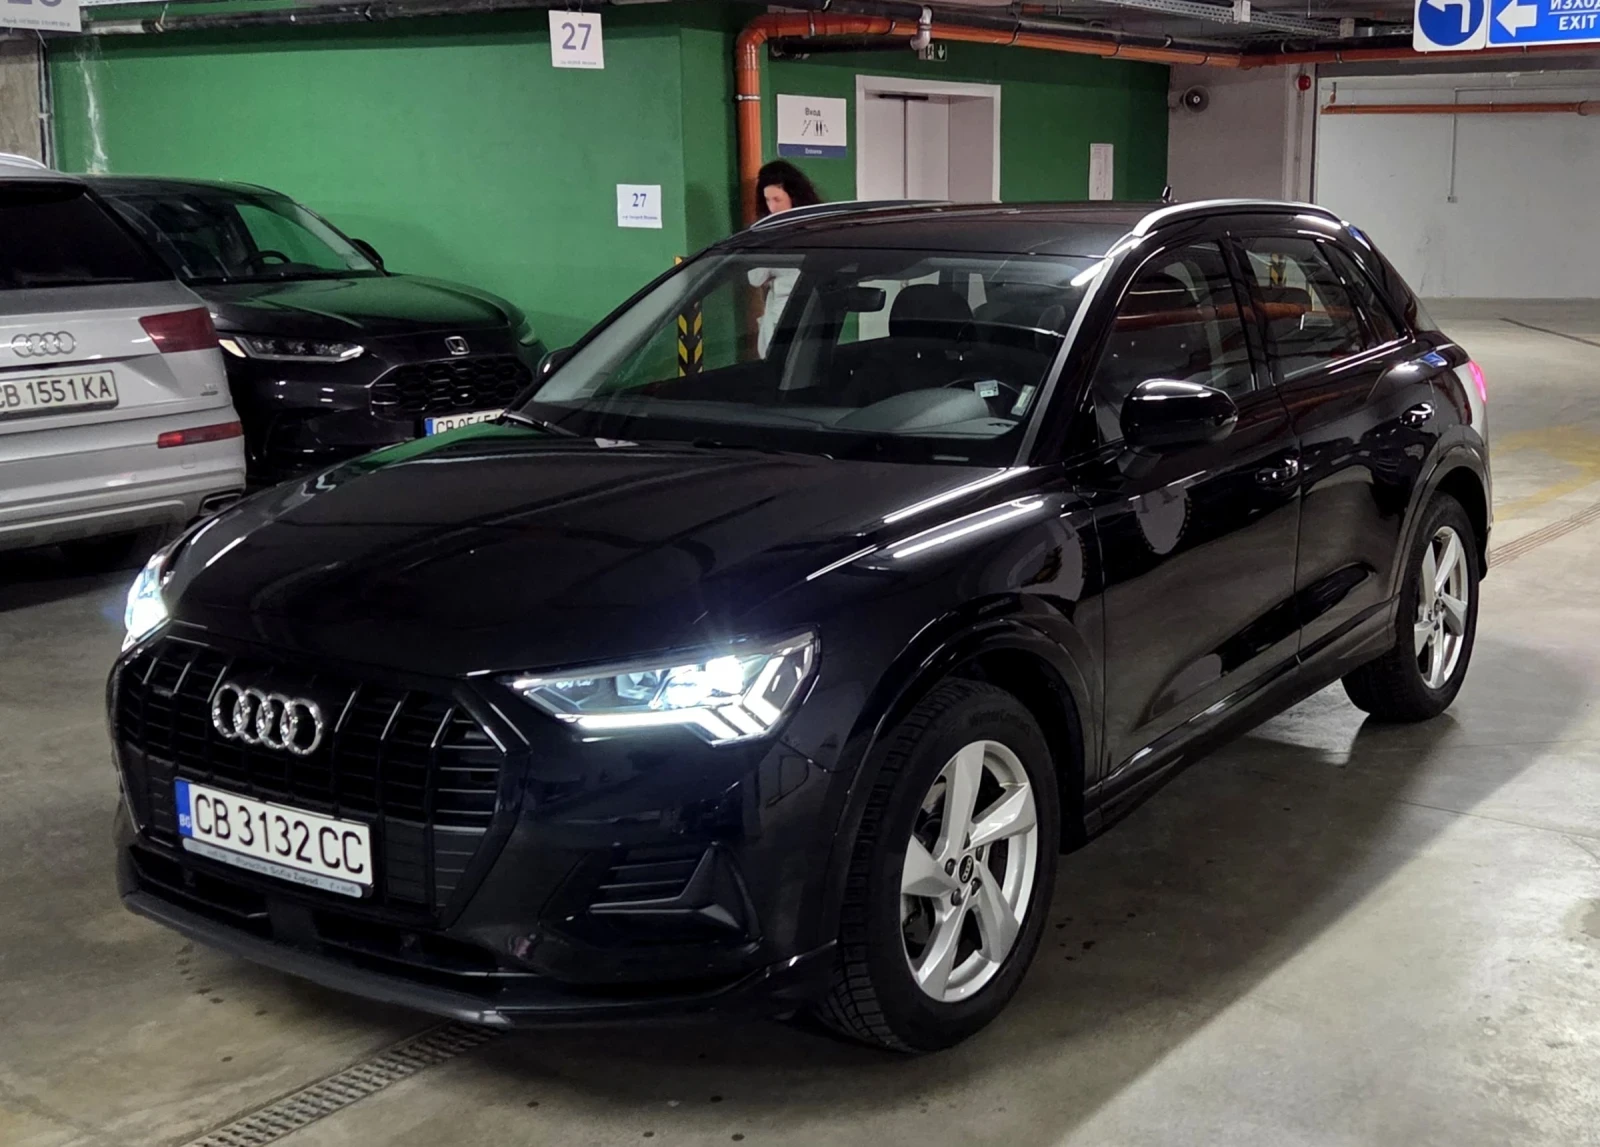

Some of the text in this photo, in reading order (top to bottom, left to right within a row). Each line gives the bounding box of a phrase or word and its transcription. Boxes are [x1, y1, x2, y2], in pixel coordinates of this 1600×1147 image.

[1558, 14, 1598, 31] EXIT
[561, 21, 592, 51] 27
[632, 192, 647, 208] 27
